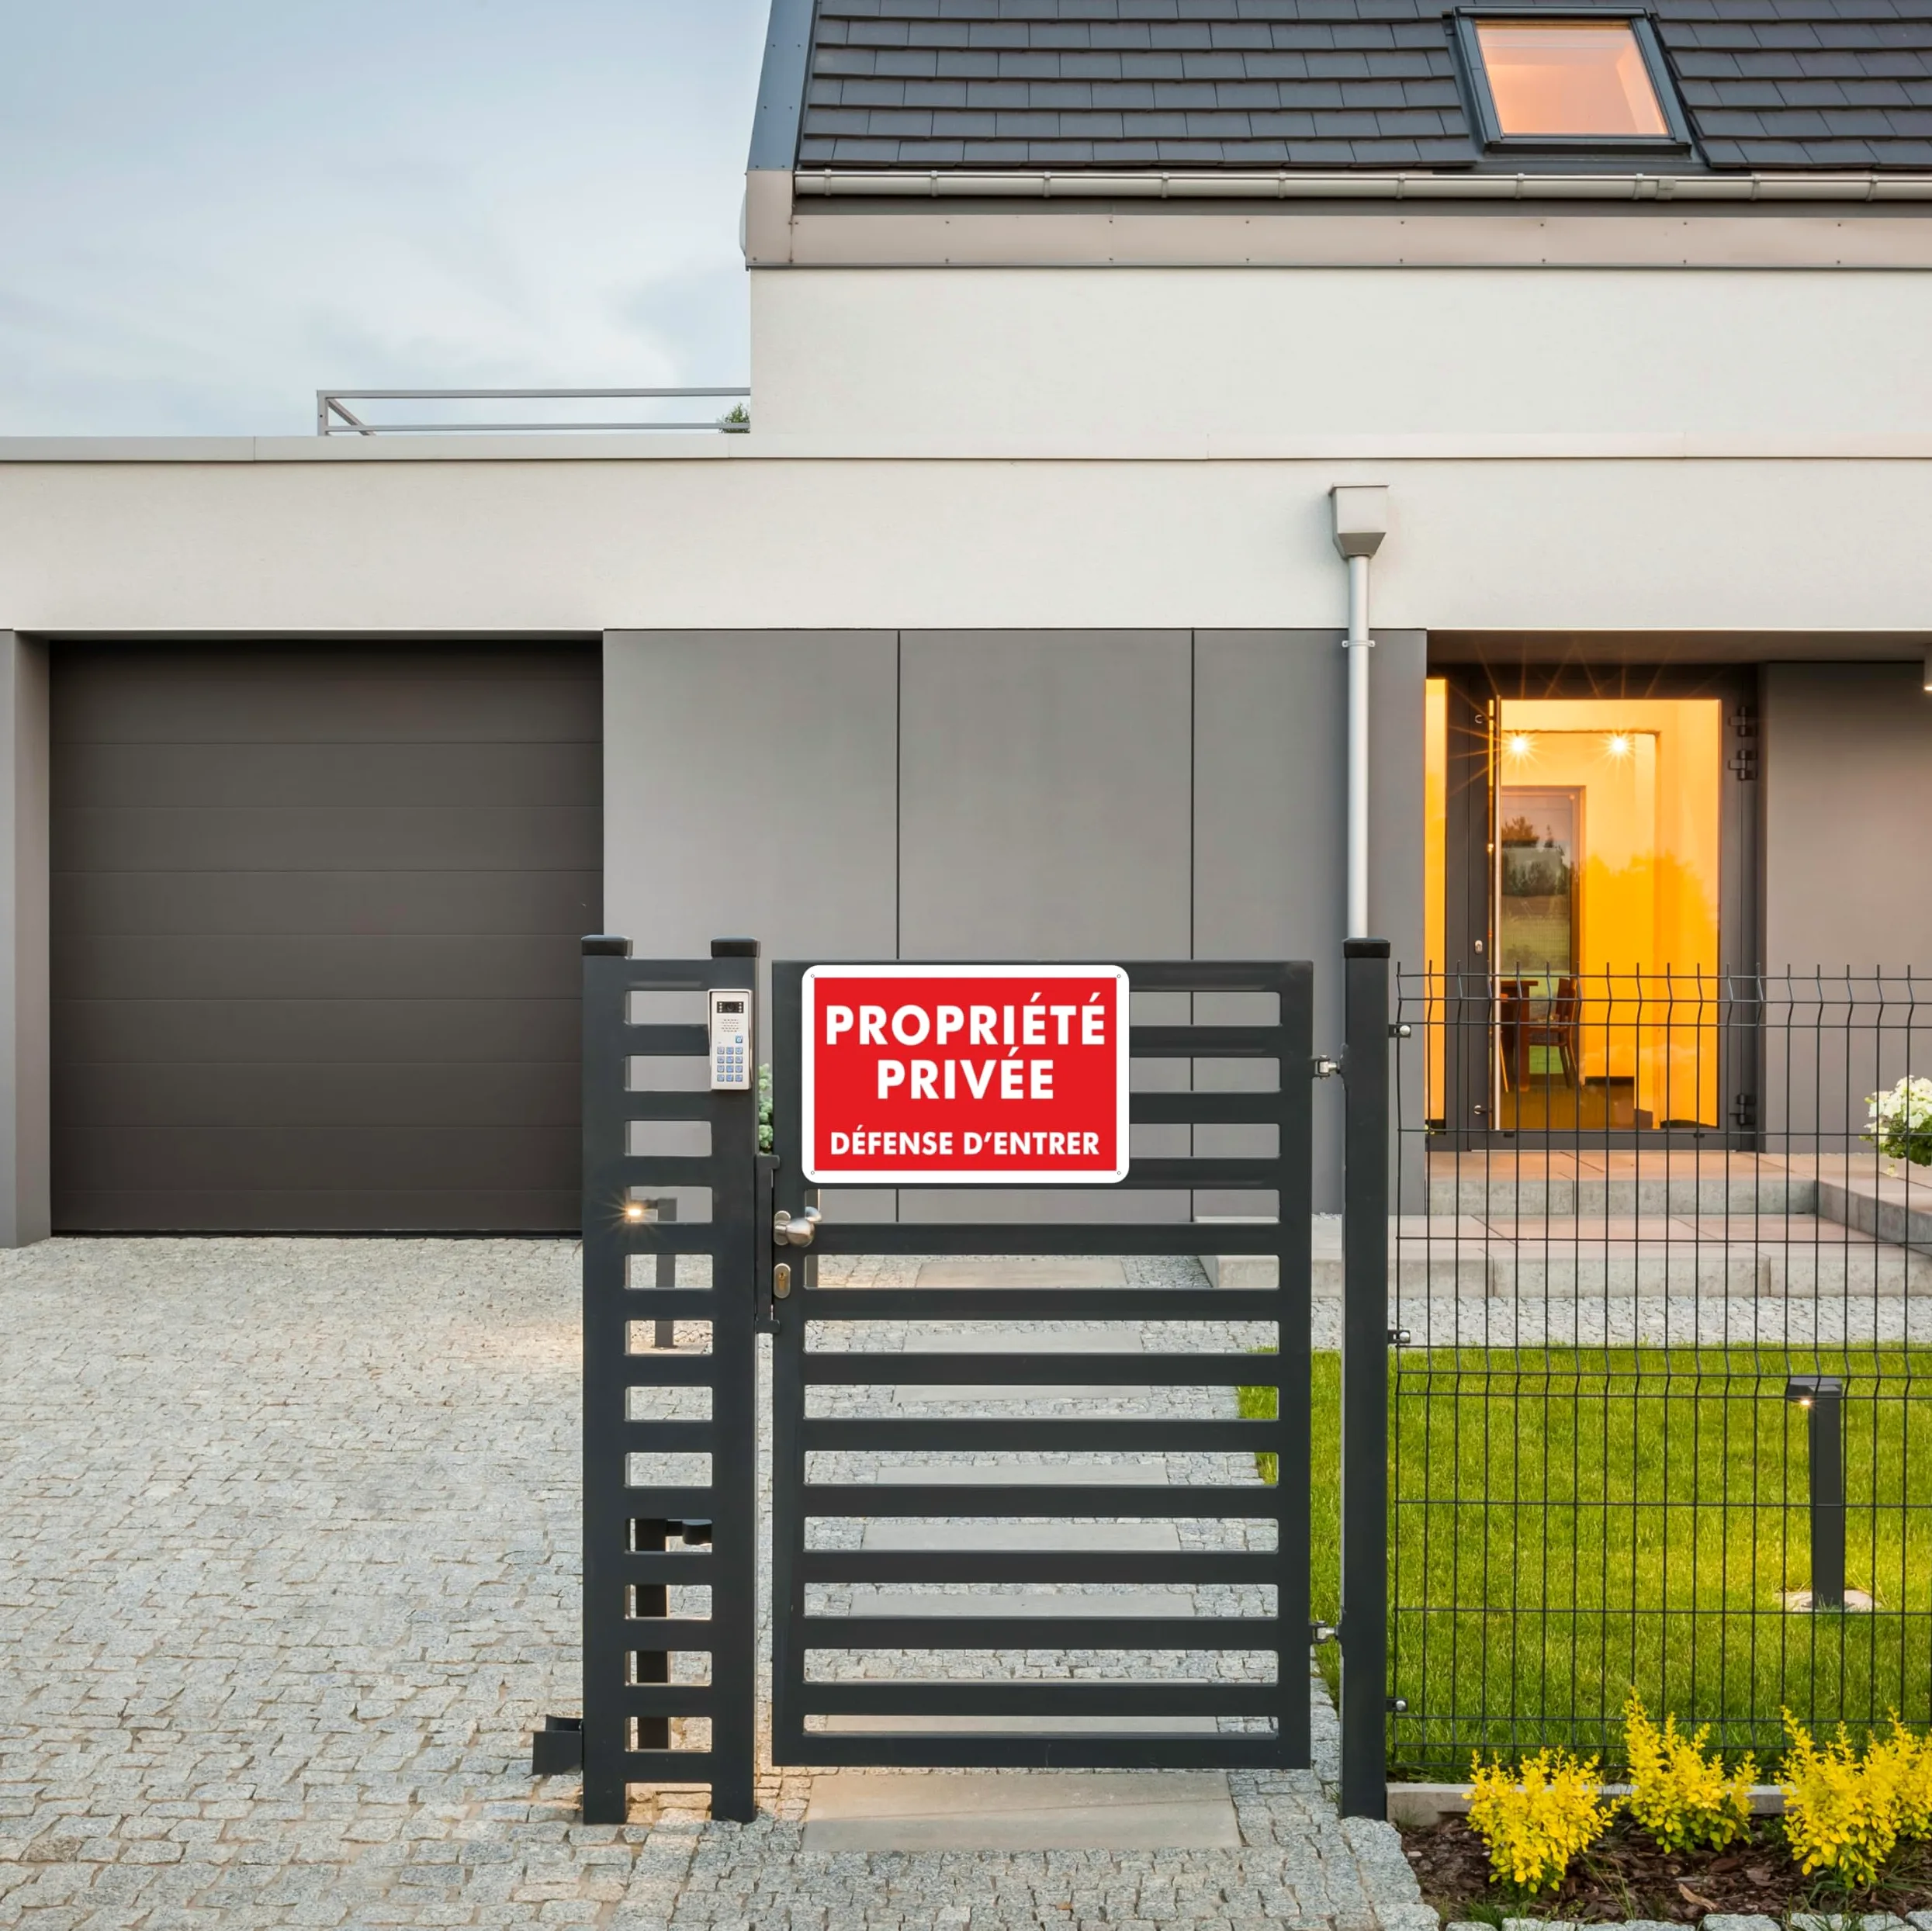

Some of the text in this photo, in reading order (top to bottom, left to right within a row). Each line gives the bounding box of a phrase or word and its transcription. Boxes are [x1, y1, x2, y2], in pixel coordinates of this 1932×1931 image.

[826, 992, 1105, 1045] PROPRIÉTÉ
[878, 1047, 1054, 1099] PRIVÉE
[831, 1125, 953, 1155] DÉFENSE
